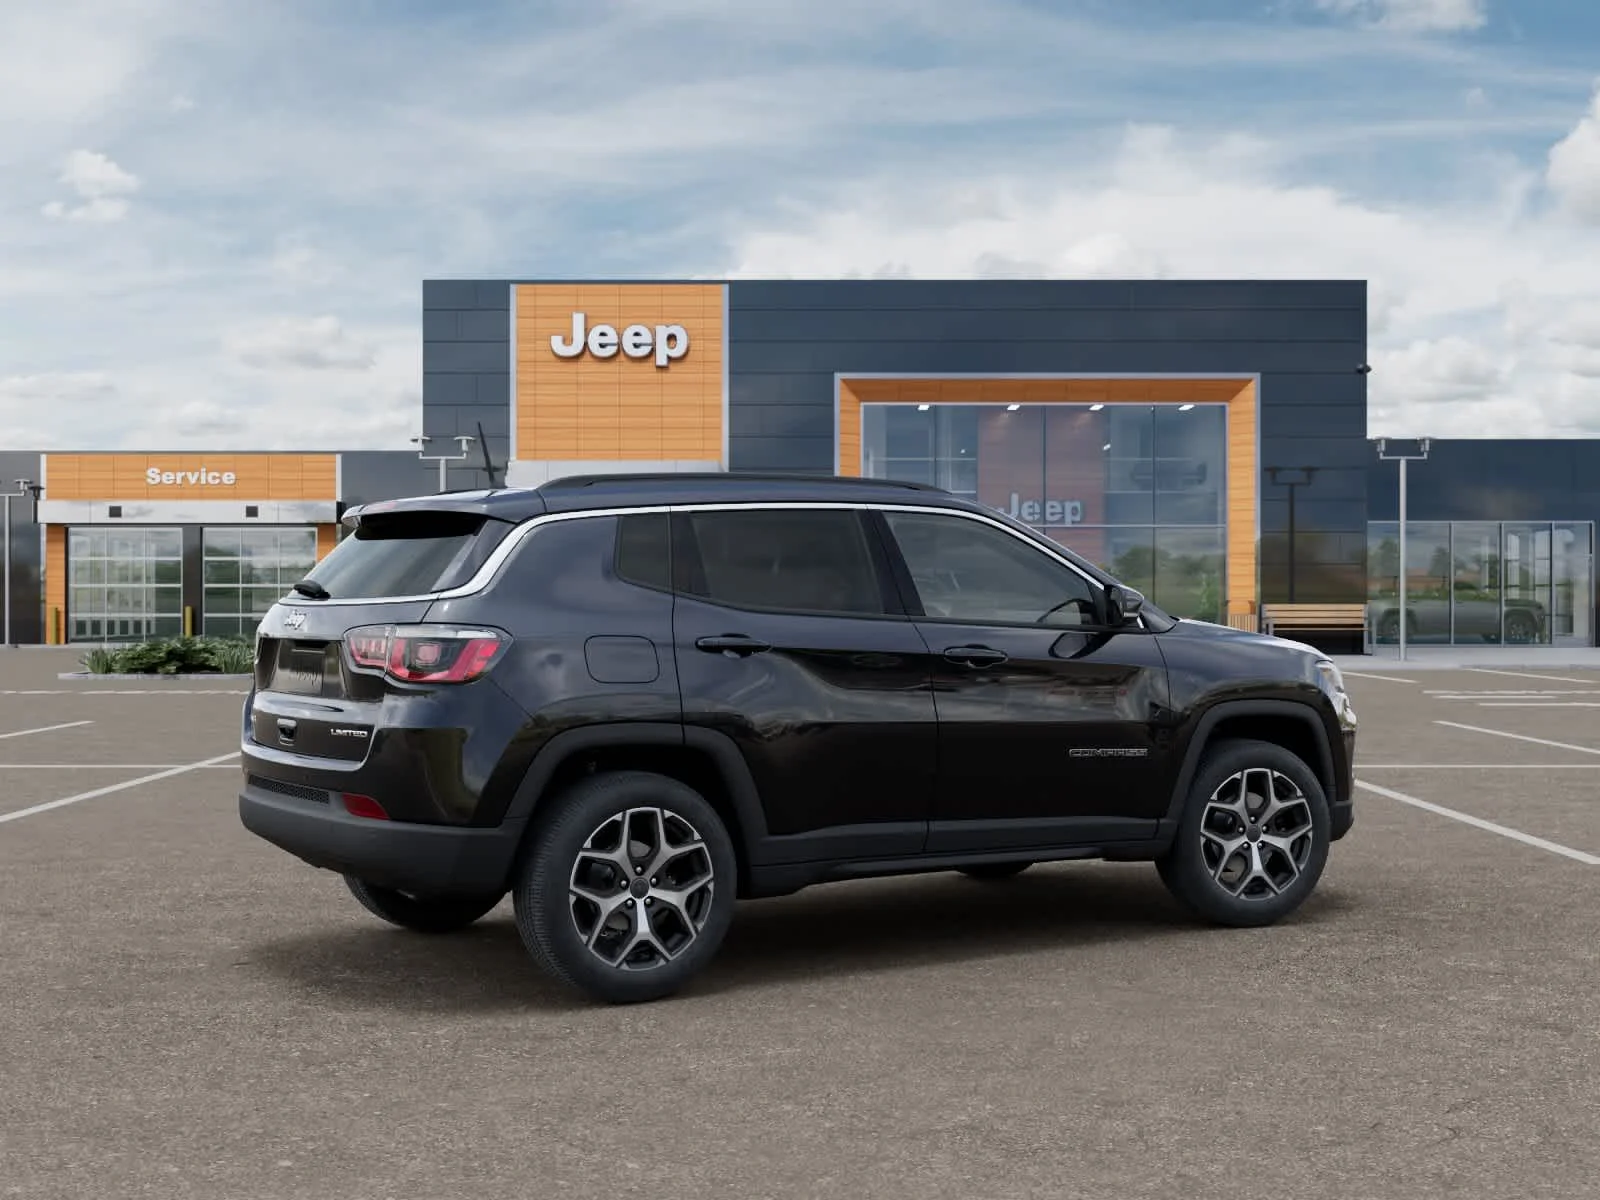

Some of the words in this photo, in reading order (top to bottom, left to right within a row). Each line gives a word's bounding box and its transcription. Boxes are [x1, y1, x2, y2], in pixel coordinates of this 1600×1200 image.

[550, 312, 688, 367] Jeep
[146, 467, 236, 485] Service
[998, 492, 1081, 526] Jeep
[330, 728, 368, 737] LIMITED
[1069, 748, 1148, 757] COMPASS
